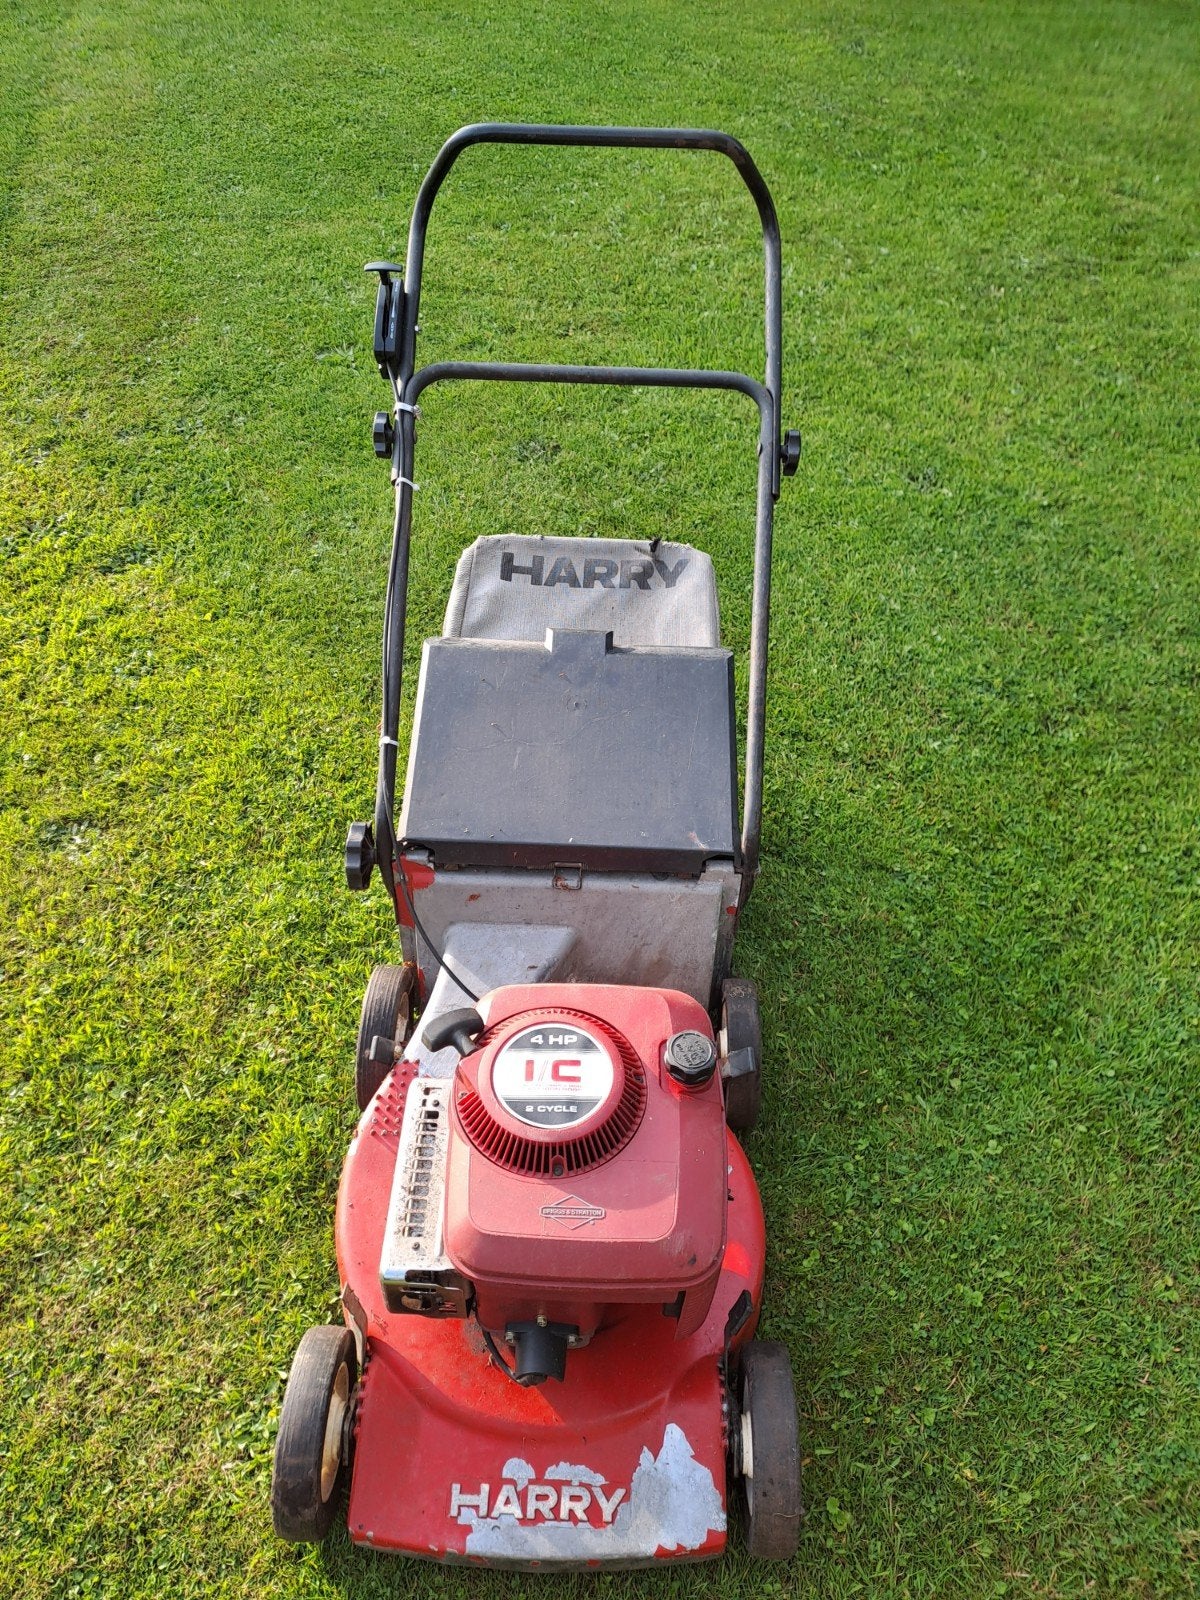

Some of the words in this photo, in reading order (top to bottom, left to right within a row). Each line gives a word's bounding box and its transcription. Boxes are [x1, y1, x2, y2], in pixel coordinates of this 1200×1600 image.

[500, 552, 690, 590] HARRY
[530, 1035, 544, 1045] 4
[548, 1035, 578, 1045] HP
[525, 1105, 534, 1113] 2
[537, 1105, 578, 1113] CYCLE
[449, 1483, 627, 1523] HARRY
